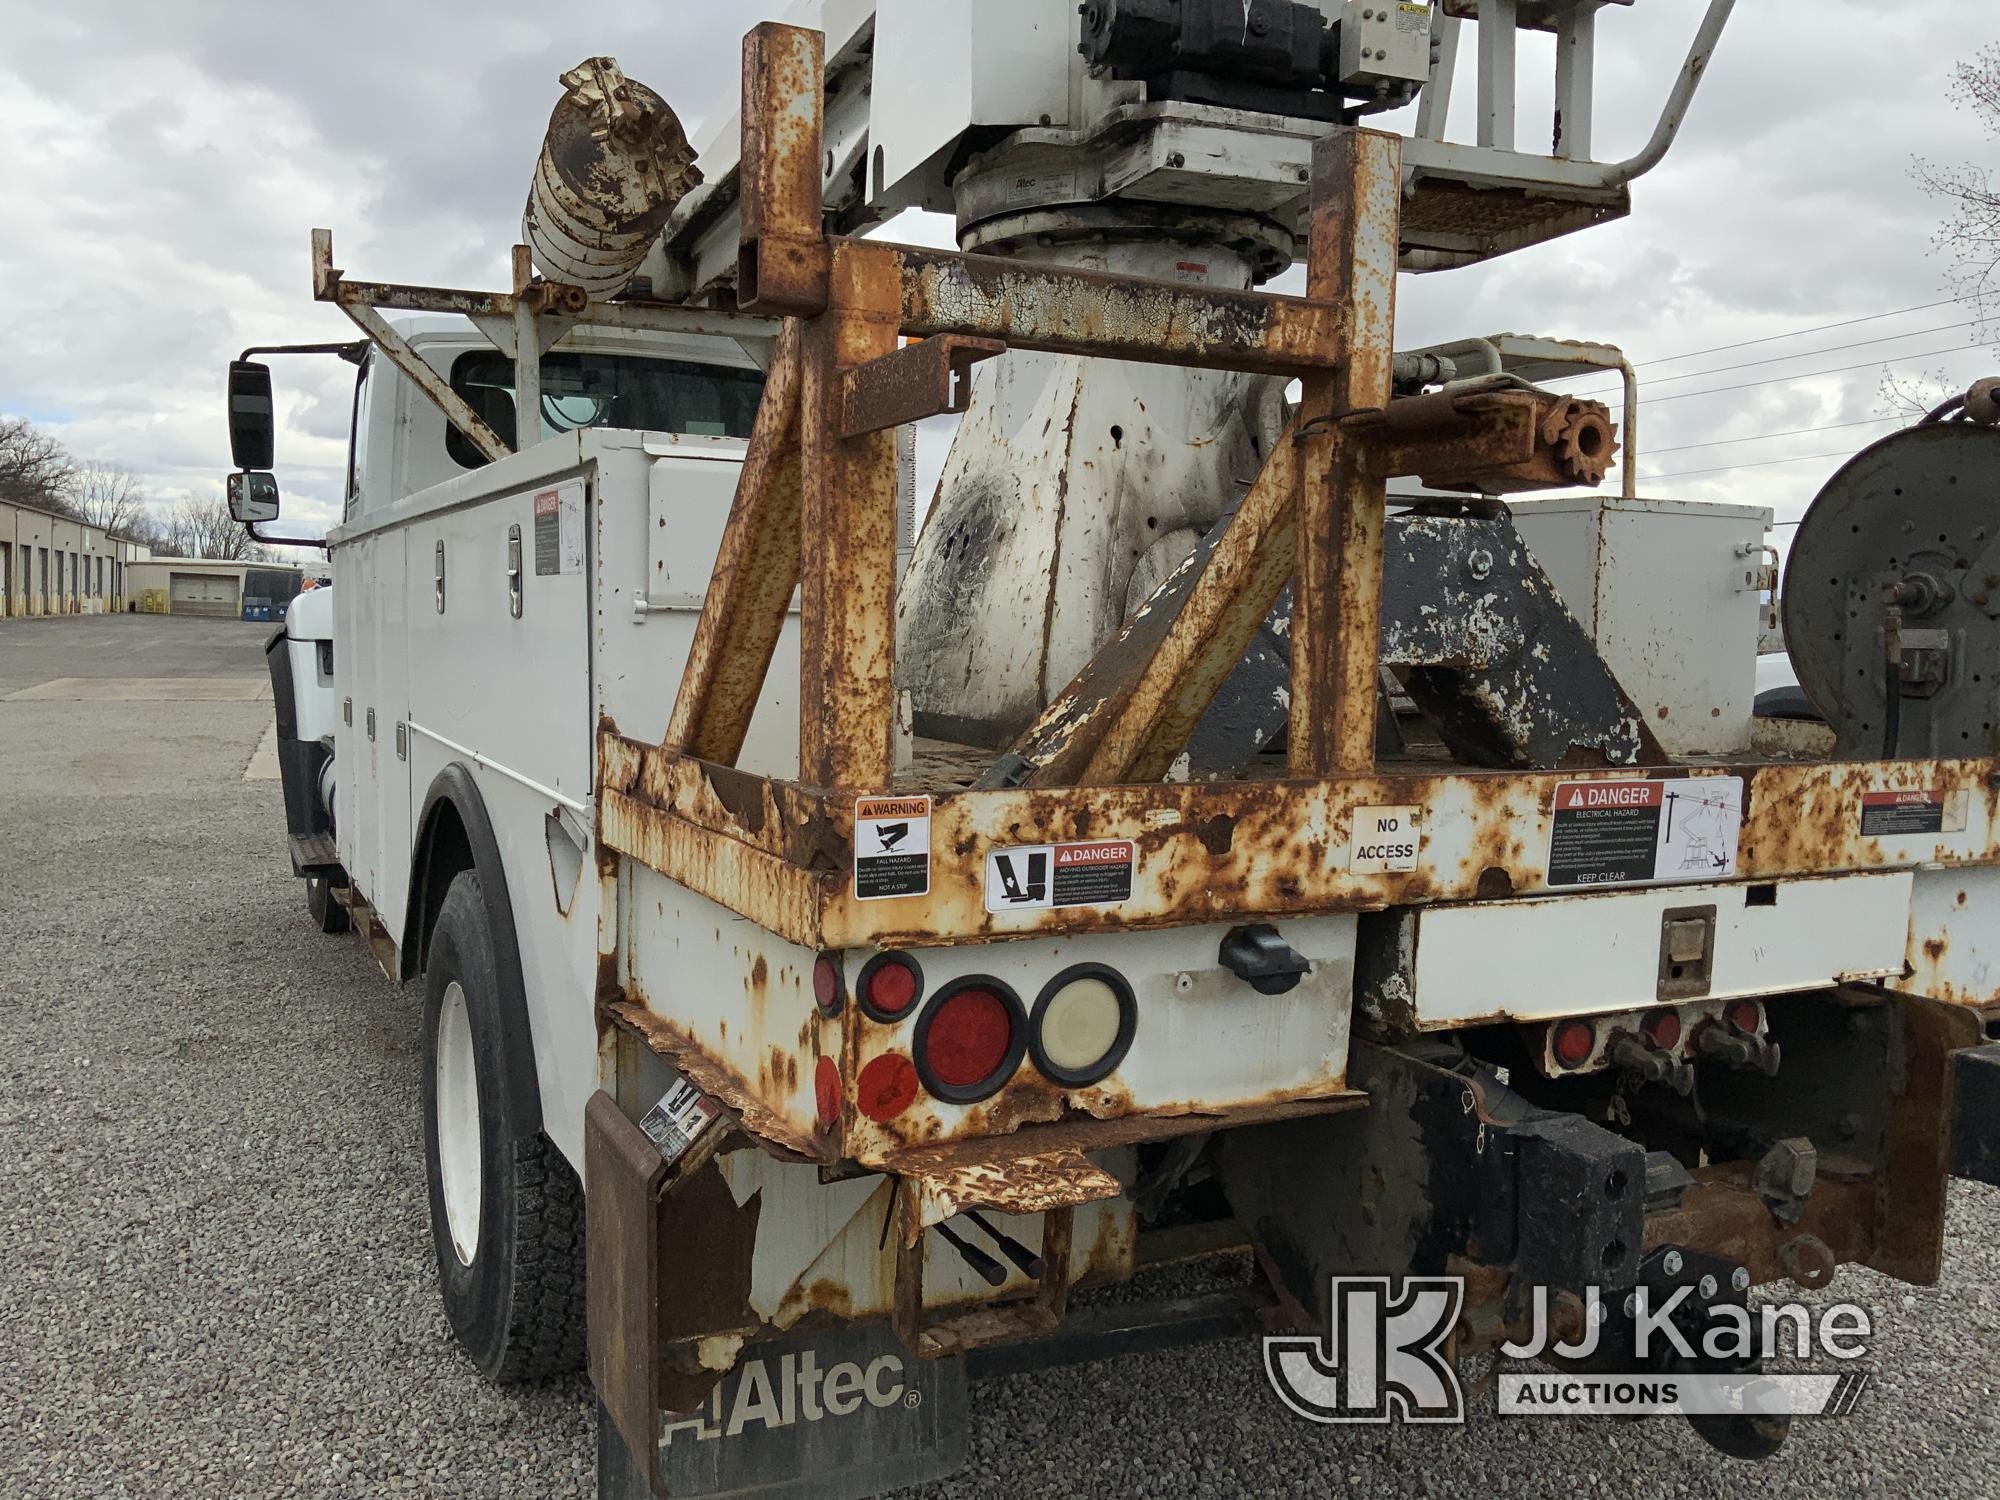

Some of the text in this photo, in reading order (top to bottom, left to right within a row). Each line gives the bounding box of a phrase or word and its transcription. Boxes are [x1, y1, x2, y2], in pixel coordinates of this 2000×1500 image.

[1587, 787, 1650, 806] DANGER
[874, 802, 925, 815] WARNING
[1576, 808, 1640, 819] ELECTRICAL HAZARD
[1377, 818, 1399, 832] NO
[1073, 847, 1127, 861] DANGER
[1357, 844, 1413, 860] ACCESS
[1577, 871, 1626, 883] KEEP CLEAR
